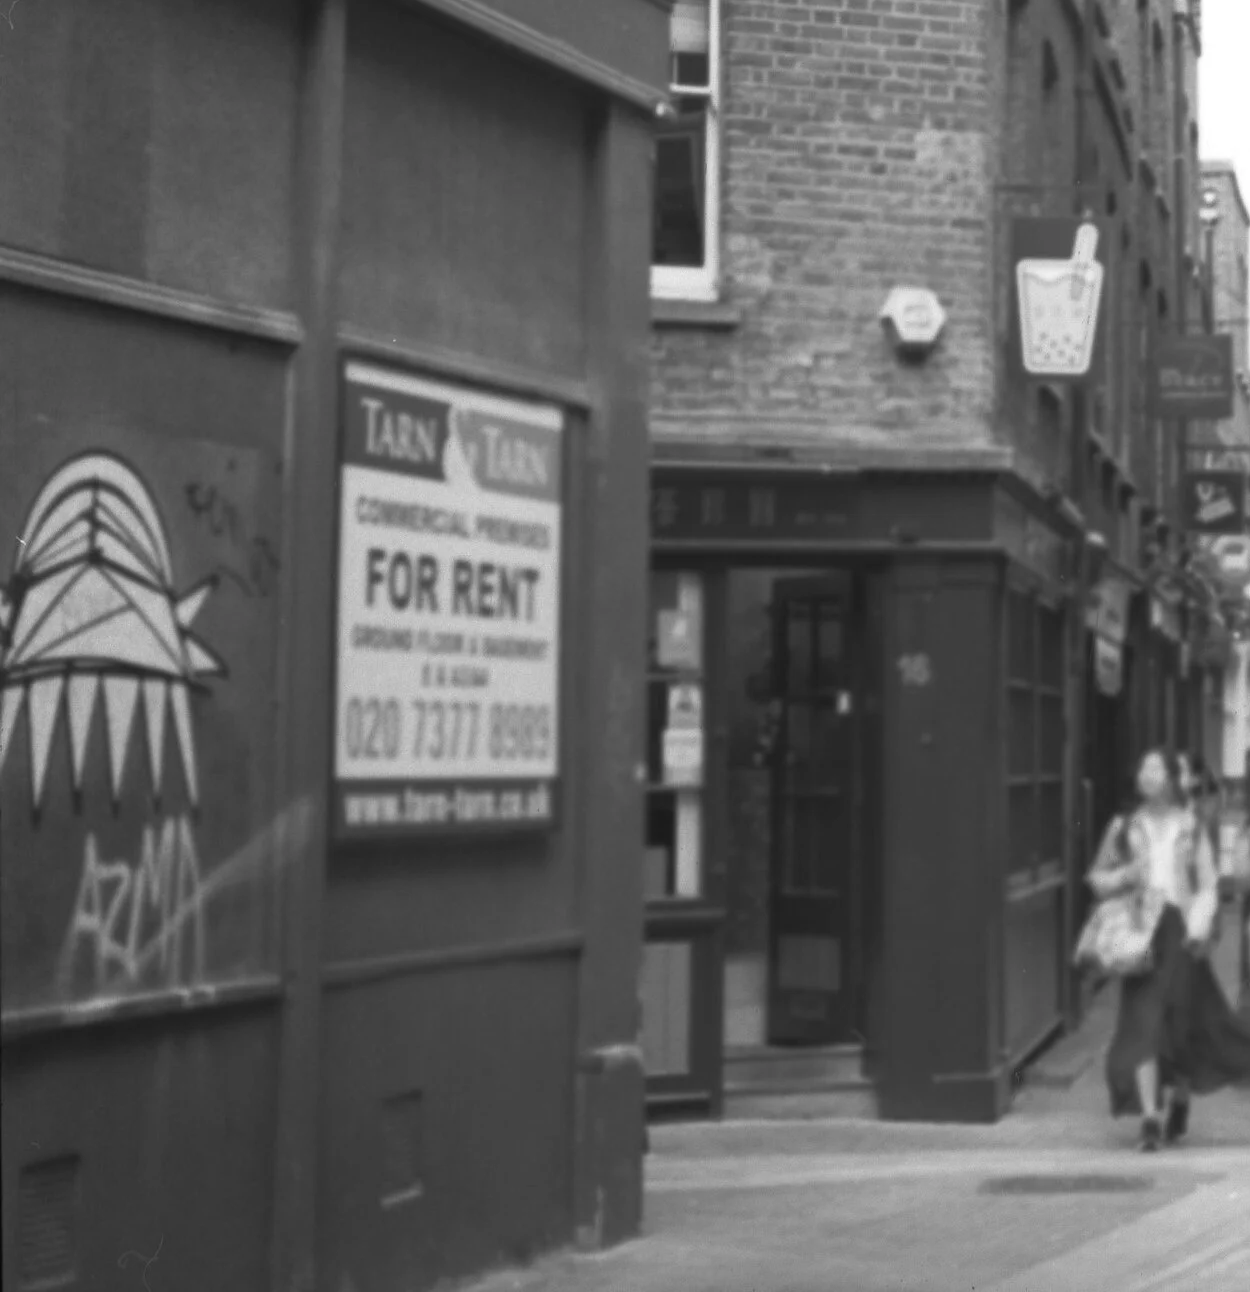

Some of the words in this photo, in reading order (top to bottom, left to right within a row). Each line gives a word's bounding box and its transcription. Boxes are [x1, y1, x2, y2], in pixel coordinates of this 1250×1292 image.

[359, 396, 439, 464] TARN
[355, 495, 470, 539] COMMERCIAL
[365, 547, 439, 613] FOR
[450, 558, 541, 623] RENT
[345, 696, 400, 761] 020
[411, 698, 481, 760] 7377
